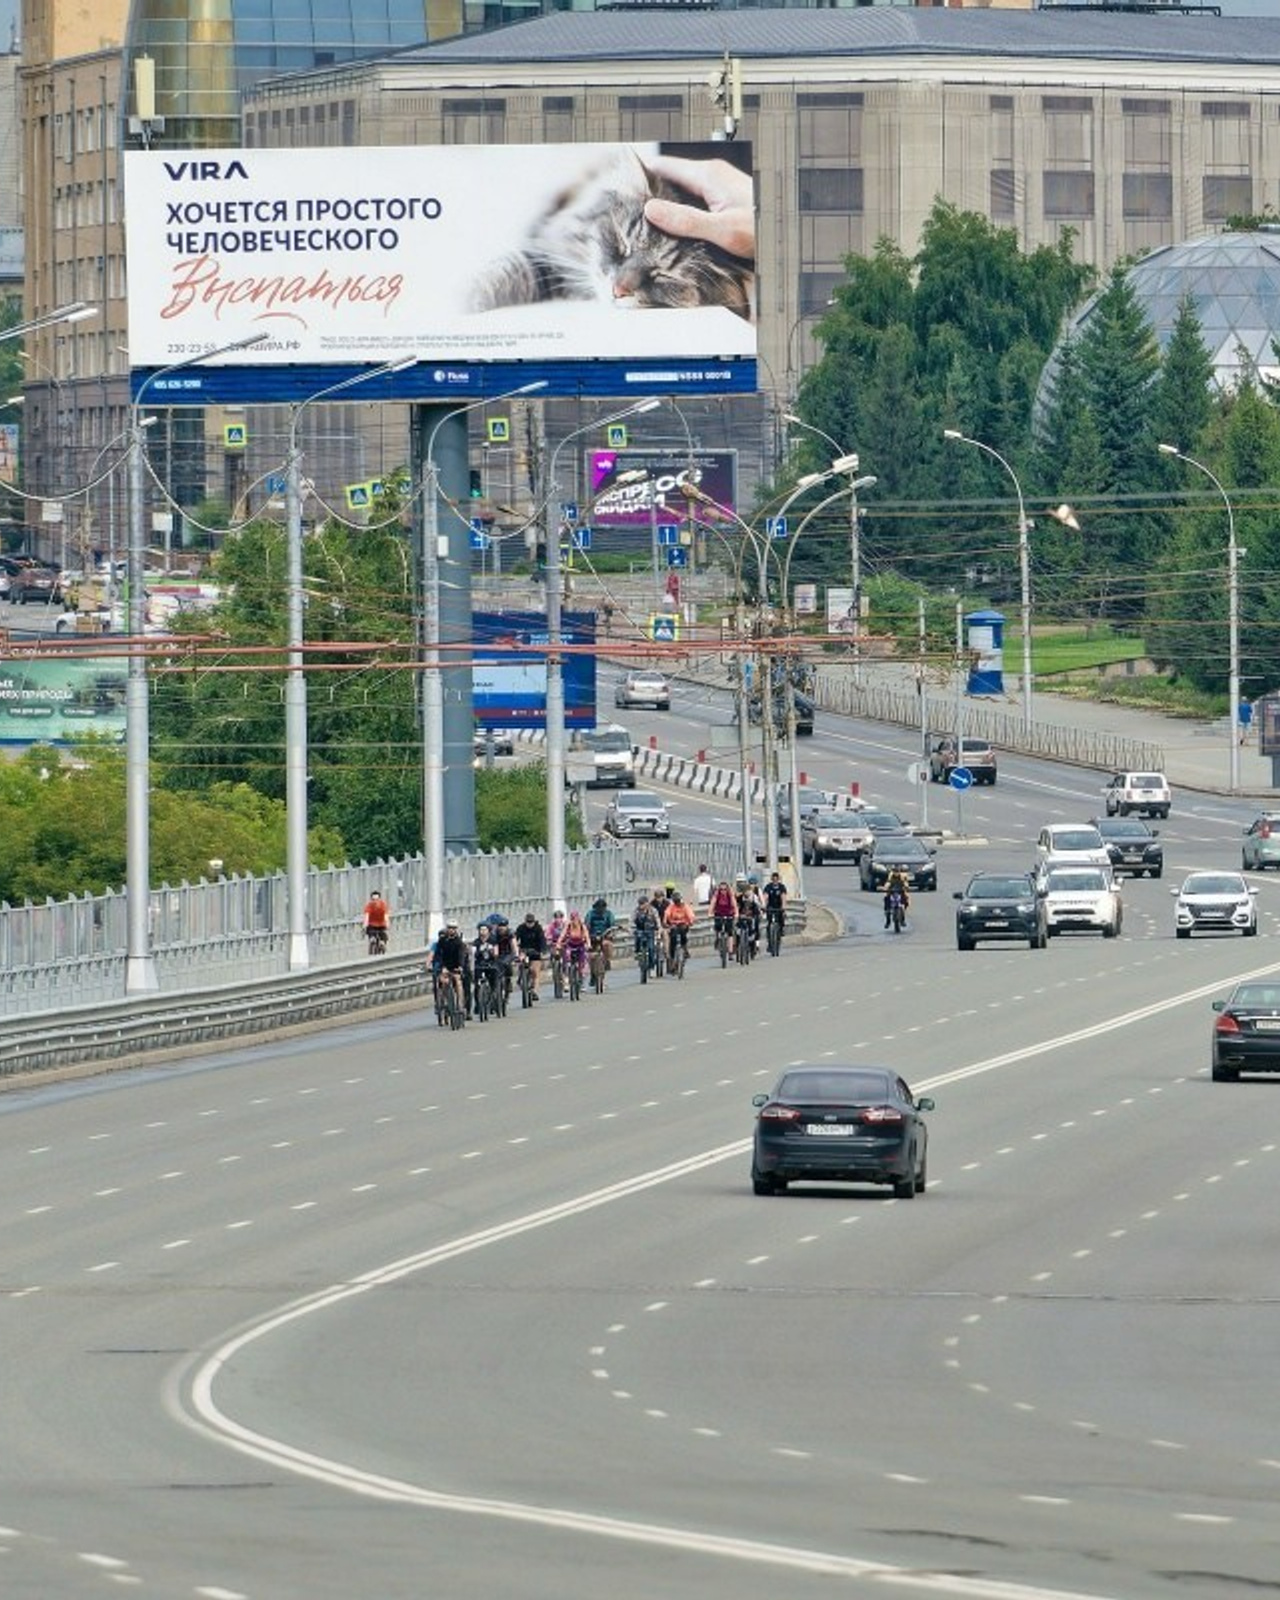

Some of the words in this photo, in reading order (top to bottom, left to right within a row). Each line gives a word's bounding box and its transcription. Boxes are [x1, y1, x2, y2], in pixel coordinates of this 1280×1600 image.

[163, 161, 249, 181] VIRA
[166, 201, 288, 225] ХОЧЕТСЯ
[295, 198, 442, 221] ПРОСТОГО
[167, 228, 399, 254] ЧЕЛОВЕЧЕСКОГО
[160, 254, 404, 321] Выспаться
[22, 689, 74, 701] ПРИРОДЫ
